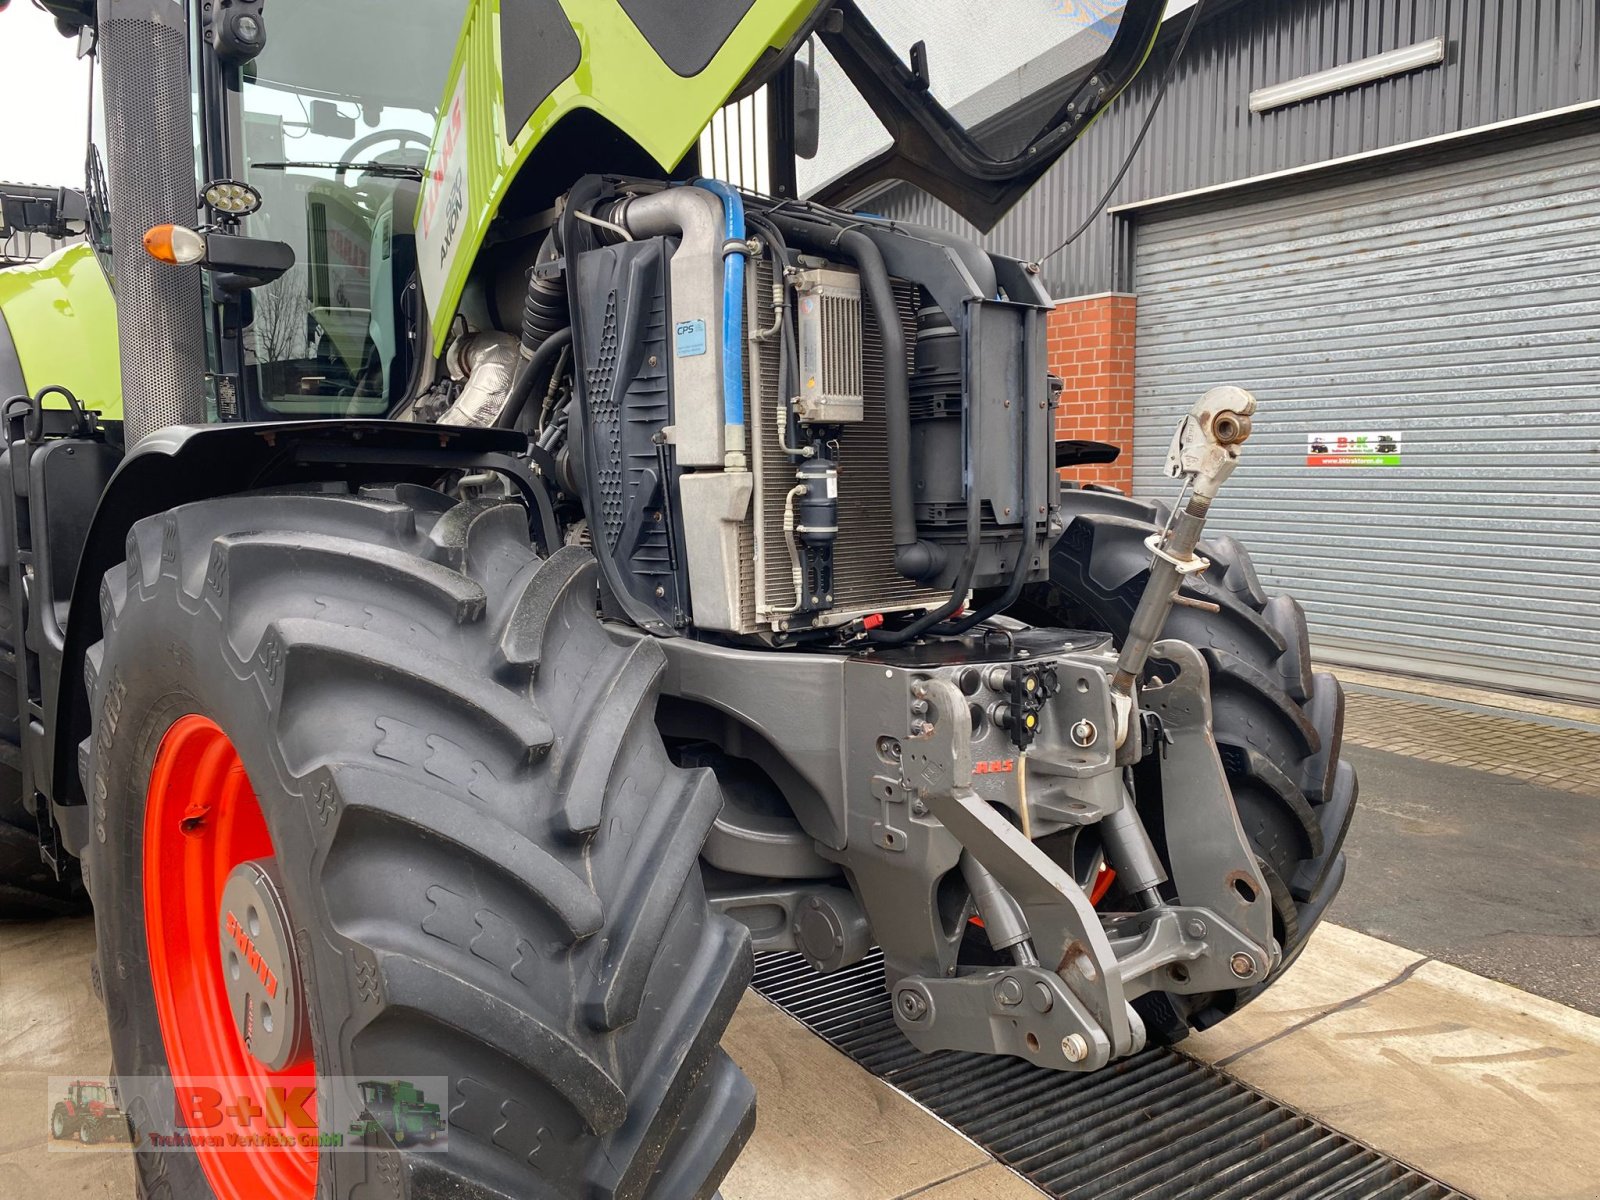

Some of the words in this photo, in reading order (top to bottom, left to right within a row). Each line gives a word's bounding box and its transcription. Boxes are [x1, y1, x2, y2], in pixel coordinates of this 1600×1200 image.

[440, 189, 462, 270] AXION
[677, 324, 694, 335] CPS
[1337, 436, 1368, 448] B+K
[225, 910, 278, 999] CLAAS
